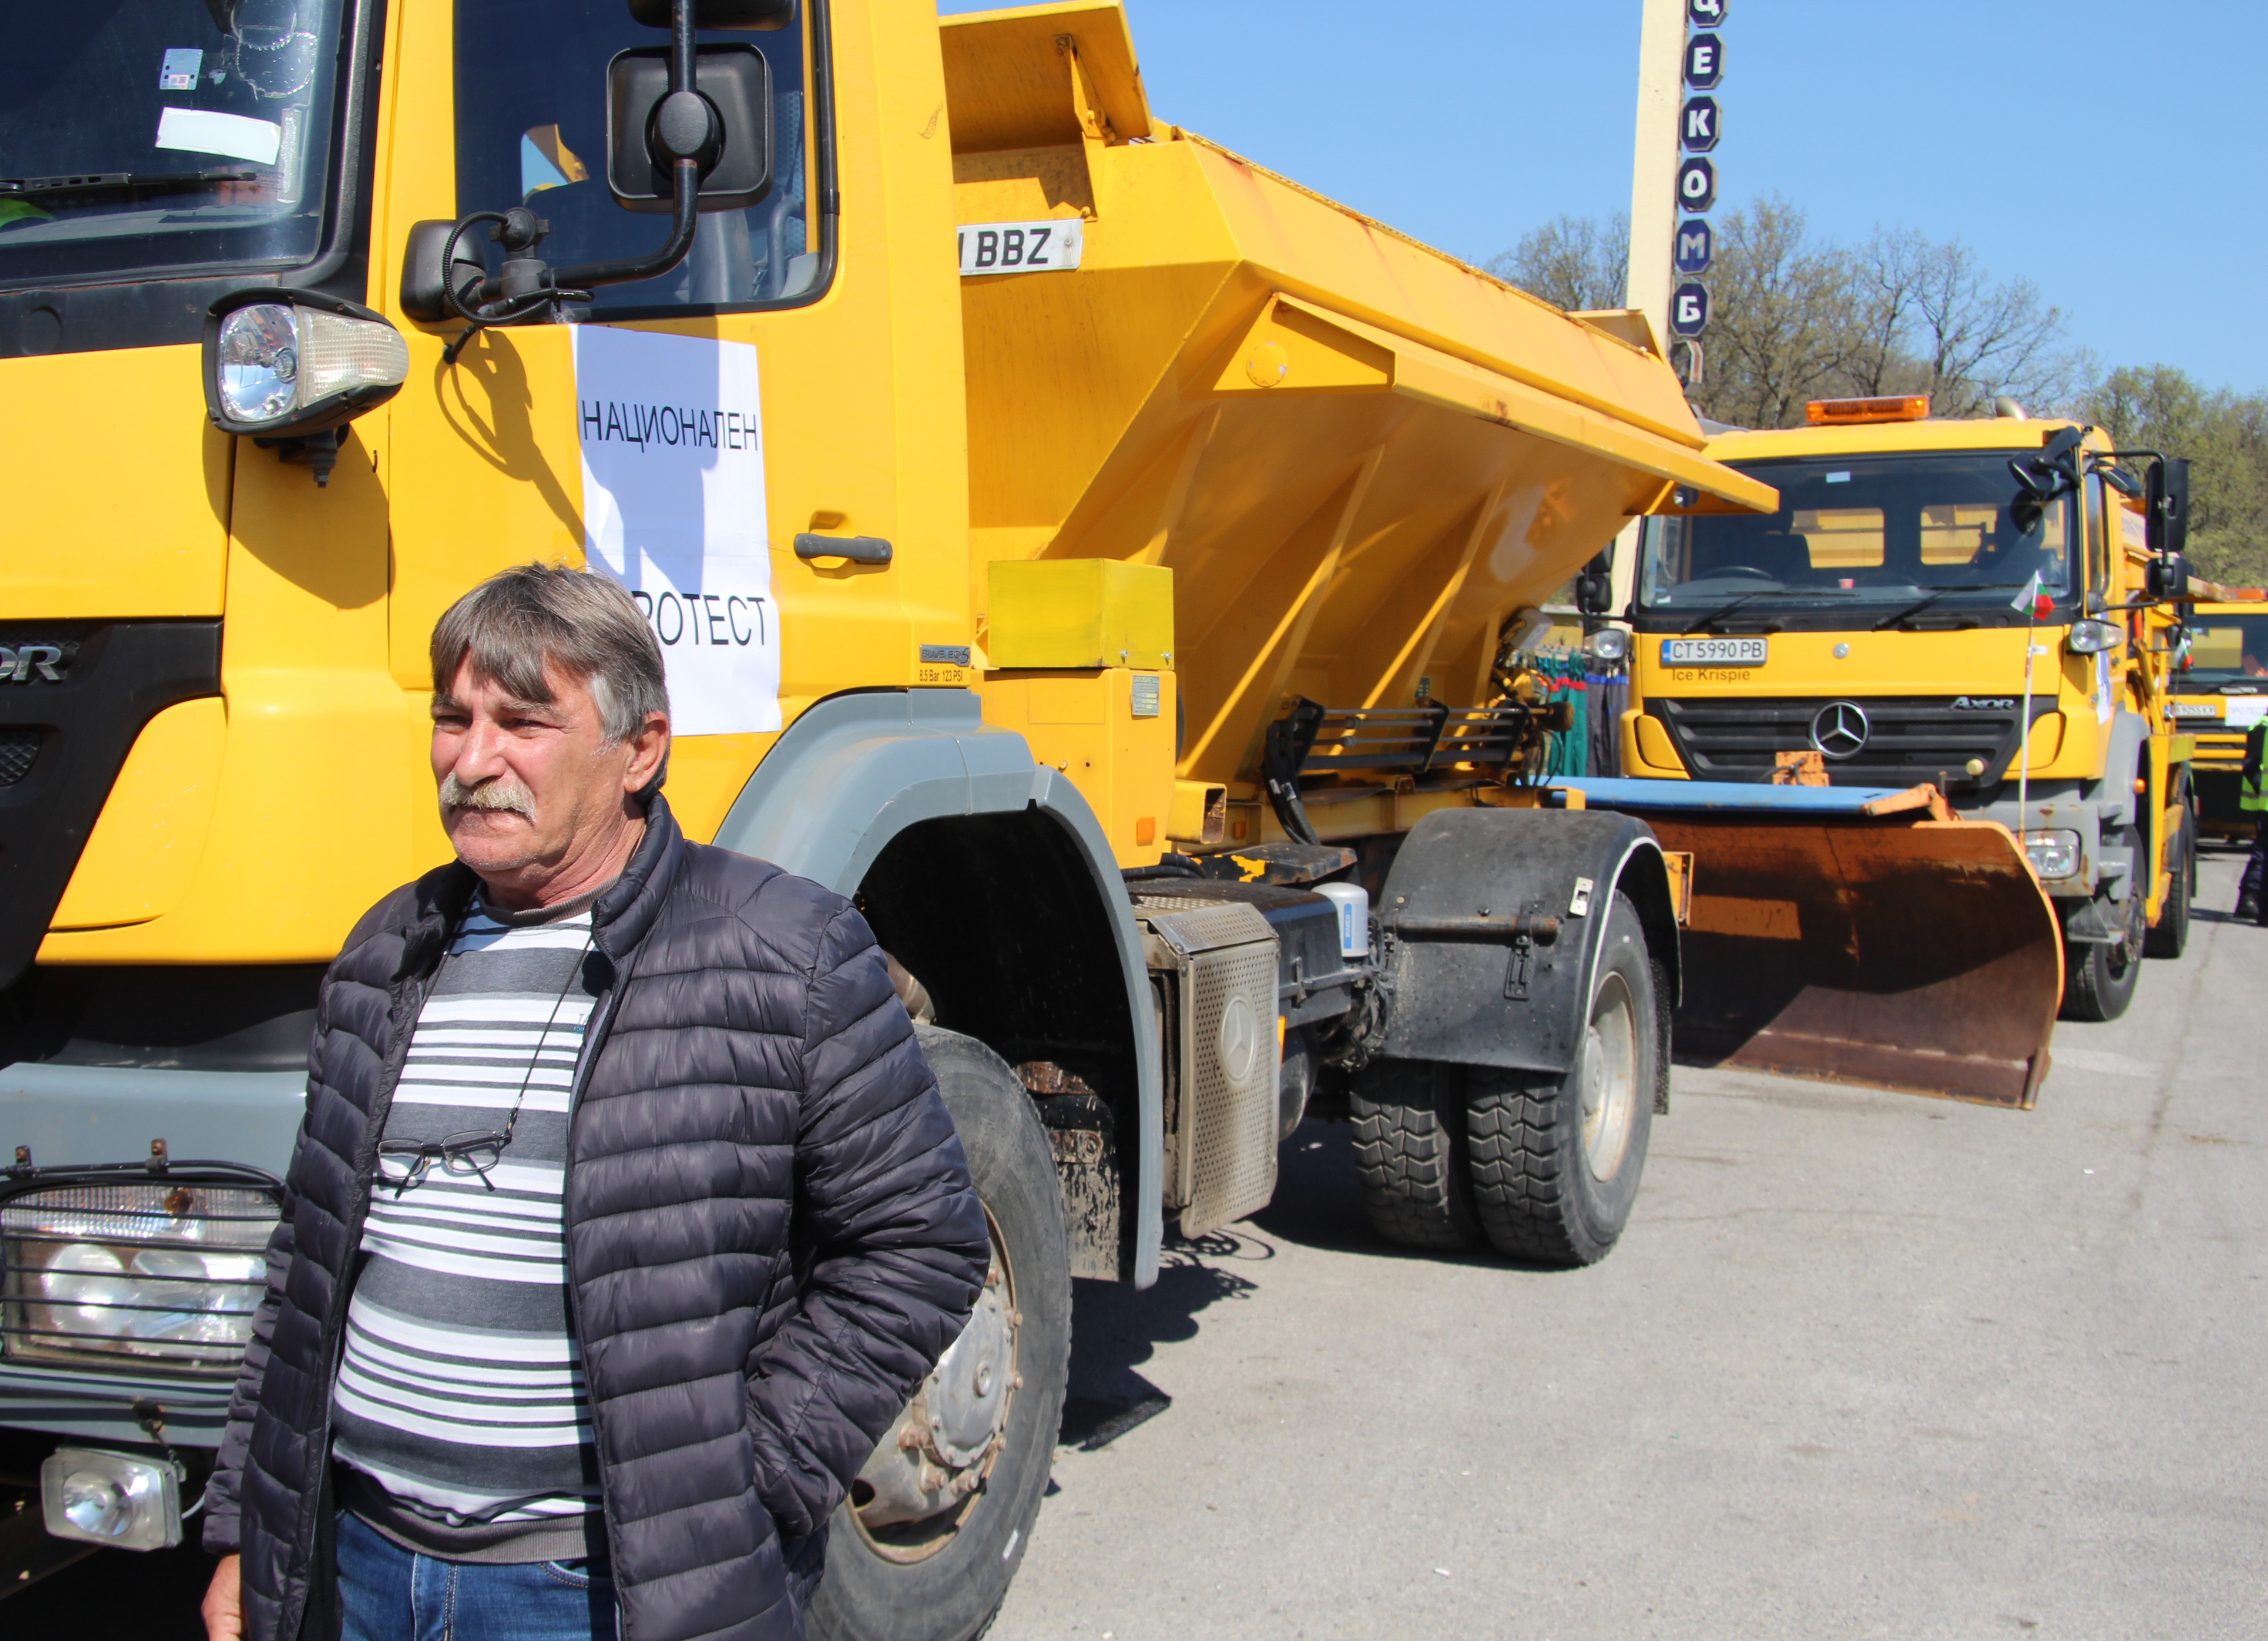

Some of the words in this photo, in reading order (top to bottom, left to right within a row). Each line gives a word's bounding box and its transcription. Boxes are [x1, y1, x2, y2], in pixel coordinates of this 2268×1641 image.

[975, 227, 1051, 268] BBZ
[581, 400, 759, 453] НАЦИОНАЛЕН
[632, 590, 766, 646] РОТЕСТ
[1697, 642, 1737, 658] 5990
[919, 670, 928, 682] 8.5
[929, 670, 940, 682] Bar
[942, 670, 952, 682] 123
[953, 670, 963, 682] PSI
[1673, 669, 1693, 681] Ice
[1698, 668, 1751, 683] Krispie
